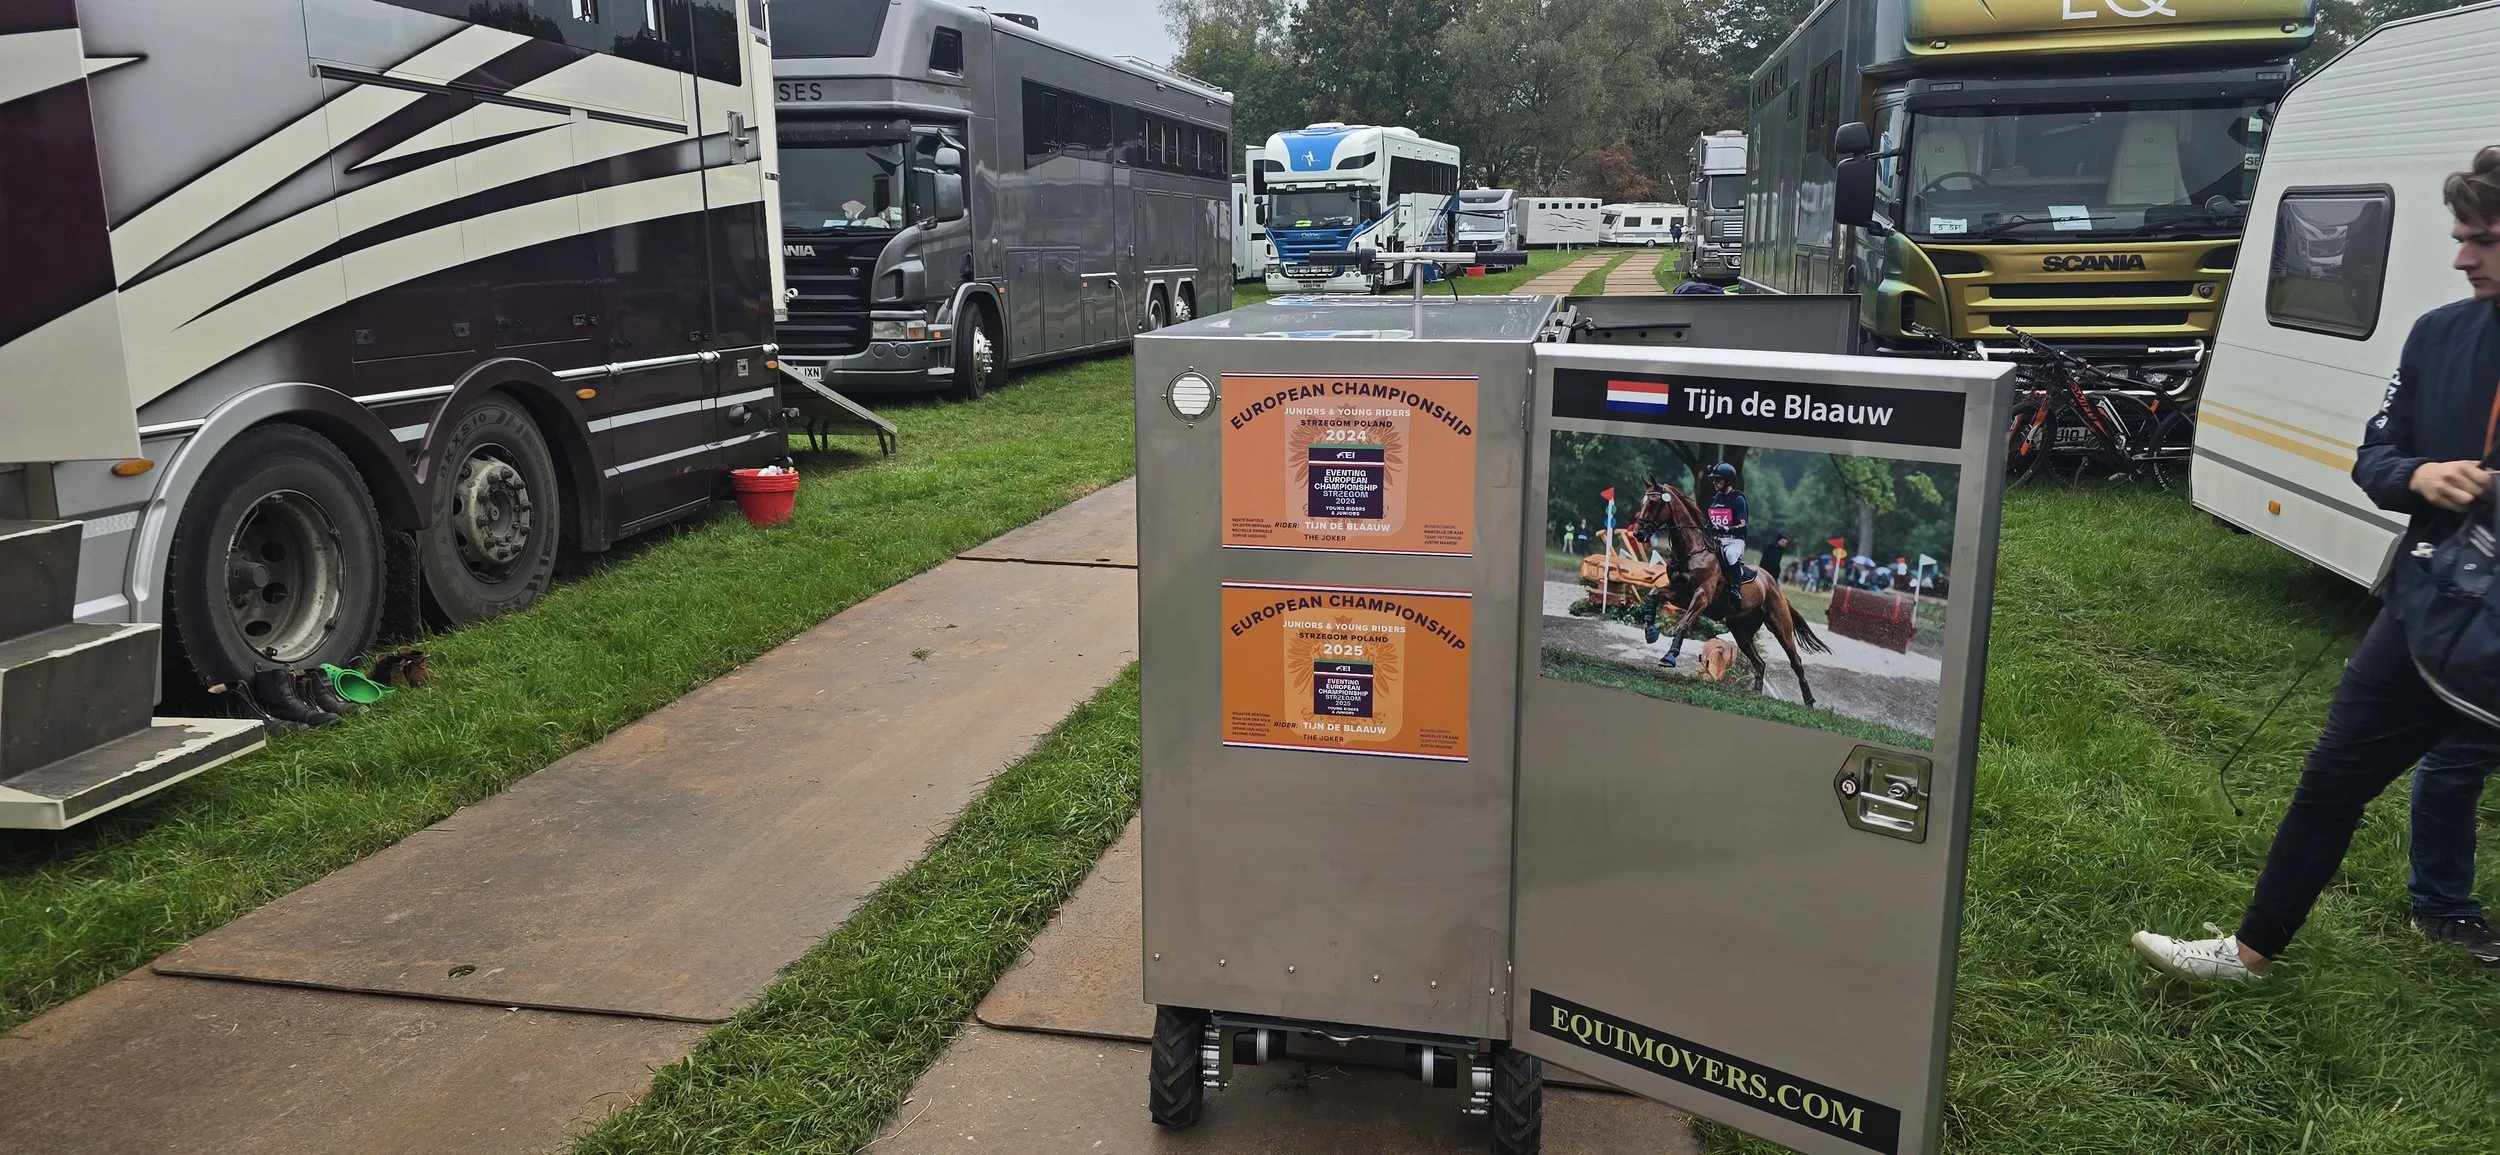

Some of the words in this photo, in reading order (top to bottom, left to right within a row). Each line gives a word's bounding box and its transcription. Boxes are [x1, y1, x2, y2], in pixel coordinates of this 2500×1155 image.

[2042, 254, 2146, 272] SCANIA
[1230, 383, 1325, 431] EUROPEAN
[1331, 382, 1472, 437] CHAMPIONSHIP
[1284, 407, 1326, 416] JUNIORS
[1328, 408, 1335, 416] &
[1338, 408, 1373, 416] YOUNG
[1375, 409, 1411, 417] RIDERS
[1683, 387, 1733, 420] Tijn
[1740, 391, 1777, 417] de
[1784, 394, 1894, 426] Blaauw
[1300, 419, 1351, 427] STRZEGOM
[1354, 420, 1393, 428] POLAND
[1326, 429, 1367, 442] 2024
[1325, 469, 1367, 477] EVENTING
[1324, 476, 1368, 484] EUROPEAN
[1314, 483, 1378, 491] CHAMPIONSHIP
[1323, 490, 1369, 498] STRZEGOM
[1335, 497, 1356, 505] 2024
[1274, 521, 1300, 529] RIDER:
[1304, 521, 1327, 529] TIJN
[1330, 522, 1343, 530] DE
[1346, 523, 1391, 532] BLAAUW
[1230, 595, 1323, 637] EUROPEAN
[1329, 595, 1466, 650] CHAMPIONSHIP
[1282, 621, 1323, 629] JUNIORS
[1335, 623, 1369, 631] YOUNG
[1371, 625, 1406, 633] RIDERS
[1299, 632, 1347, 641] STRZEGOM
[1351, 635, 1389, 643] POLAND
[1323, 643, 1364, 656] 2025
[1318, 688, 1369, 696] CHAMPIONSHIP
[1273, 721, 1299, 729] RIDER:
[1303, 722, 1325, 730] TIJN
[1327, 723, 1341, 731] DE
[1343, 724, 1387, 735] BLAAUW
[1550, 1004, 1864, 1134] EQUIMOVERS.COM
